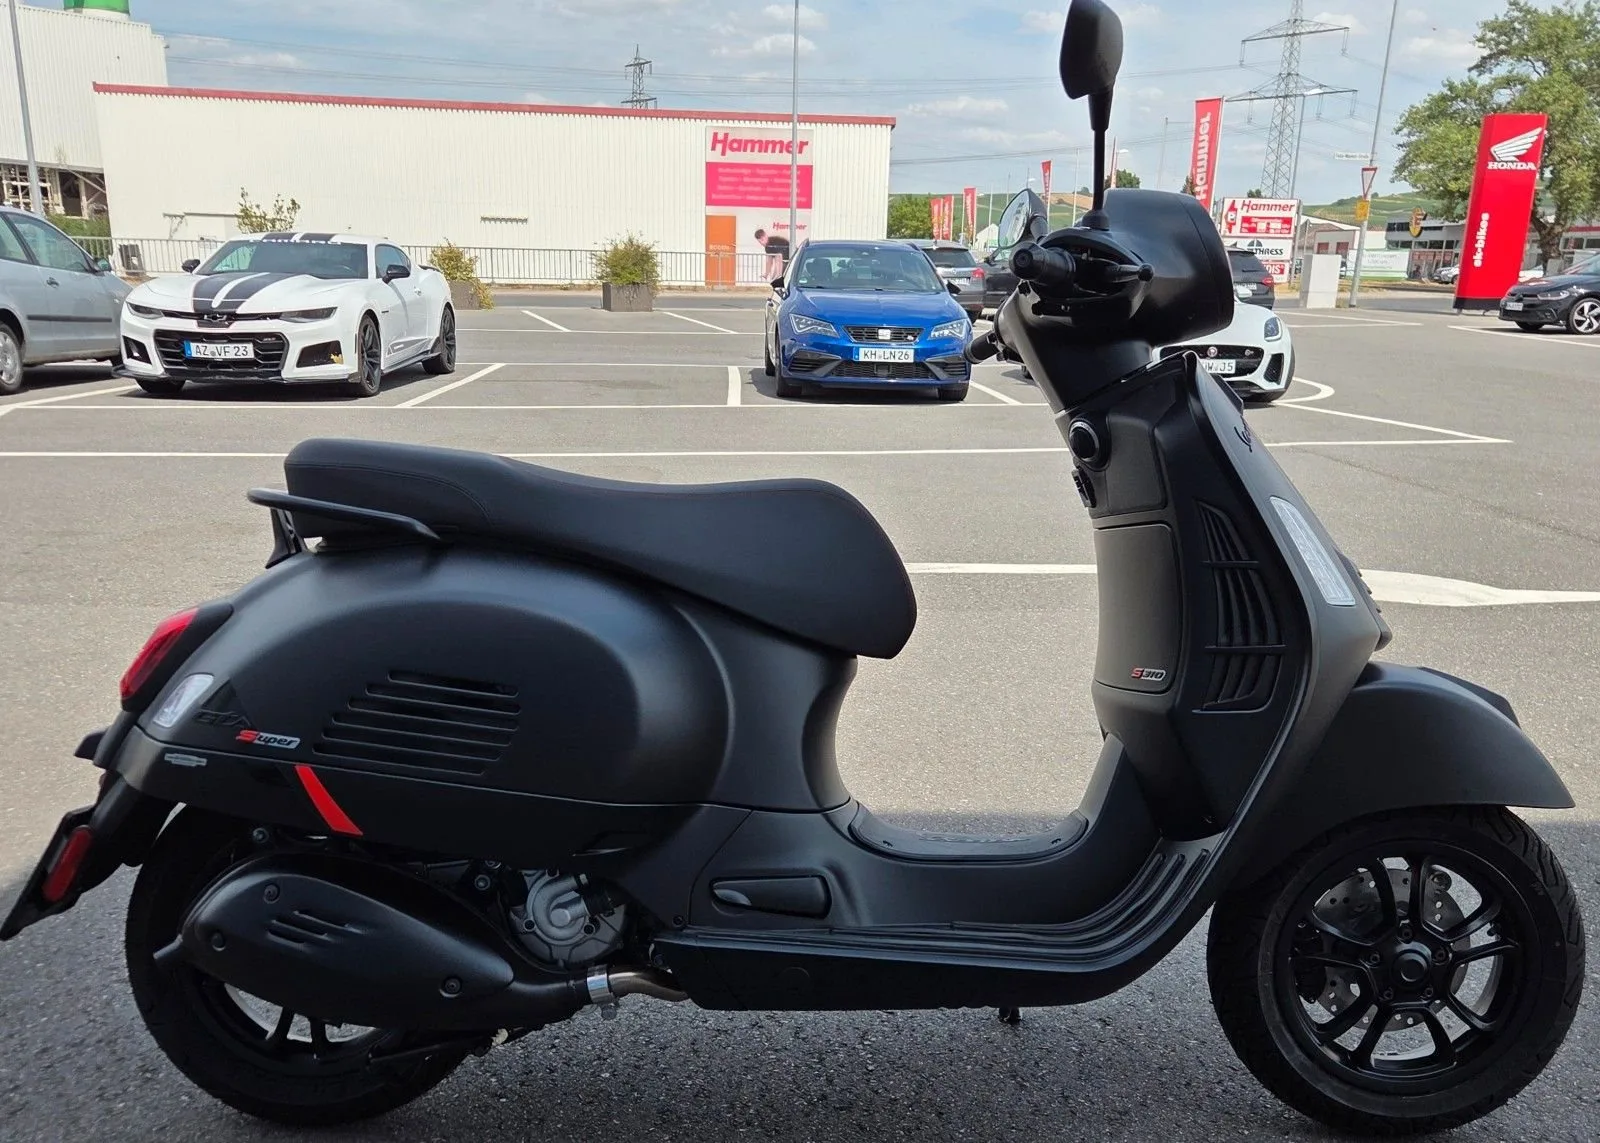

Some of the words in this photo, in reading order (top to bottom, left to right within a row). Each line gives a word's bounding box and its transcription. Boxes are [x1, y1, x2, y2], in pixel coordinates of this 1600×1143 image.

[711, 131, 809, 156] Hammer
[1194, 111, 1211, 200] Hammer
[1487, 161, 1537, 170] HONDA
[1241, 200, 1295, 213] Hammer
[772, 222, 808, 231] Hamer
[195, 345, 210, 356] AZ
[215, 345, 230, 356] VF
[233, 346, 248, 357] 23
[863, 350, 877, 360] KH
[235, 729, 300, 749] Super
